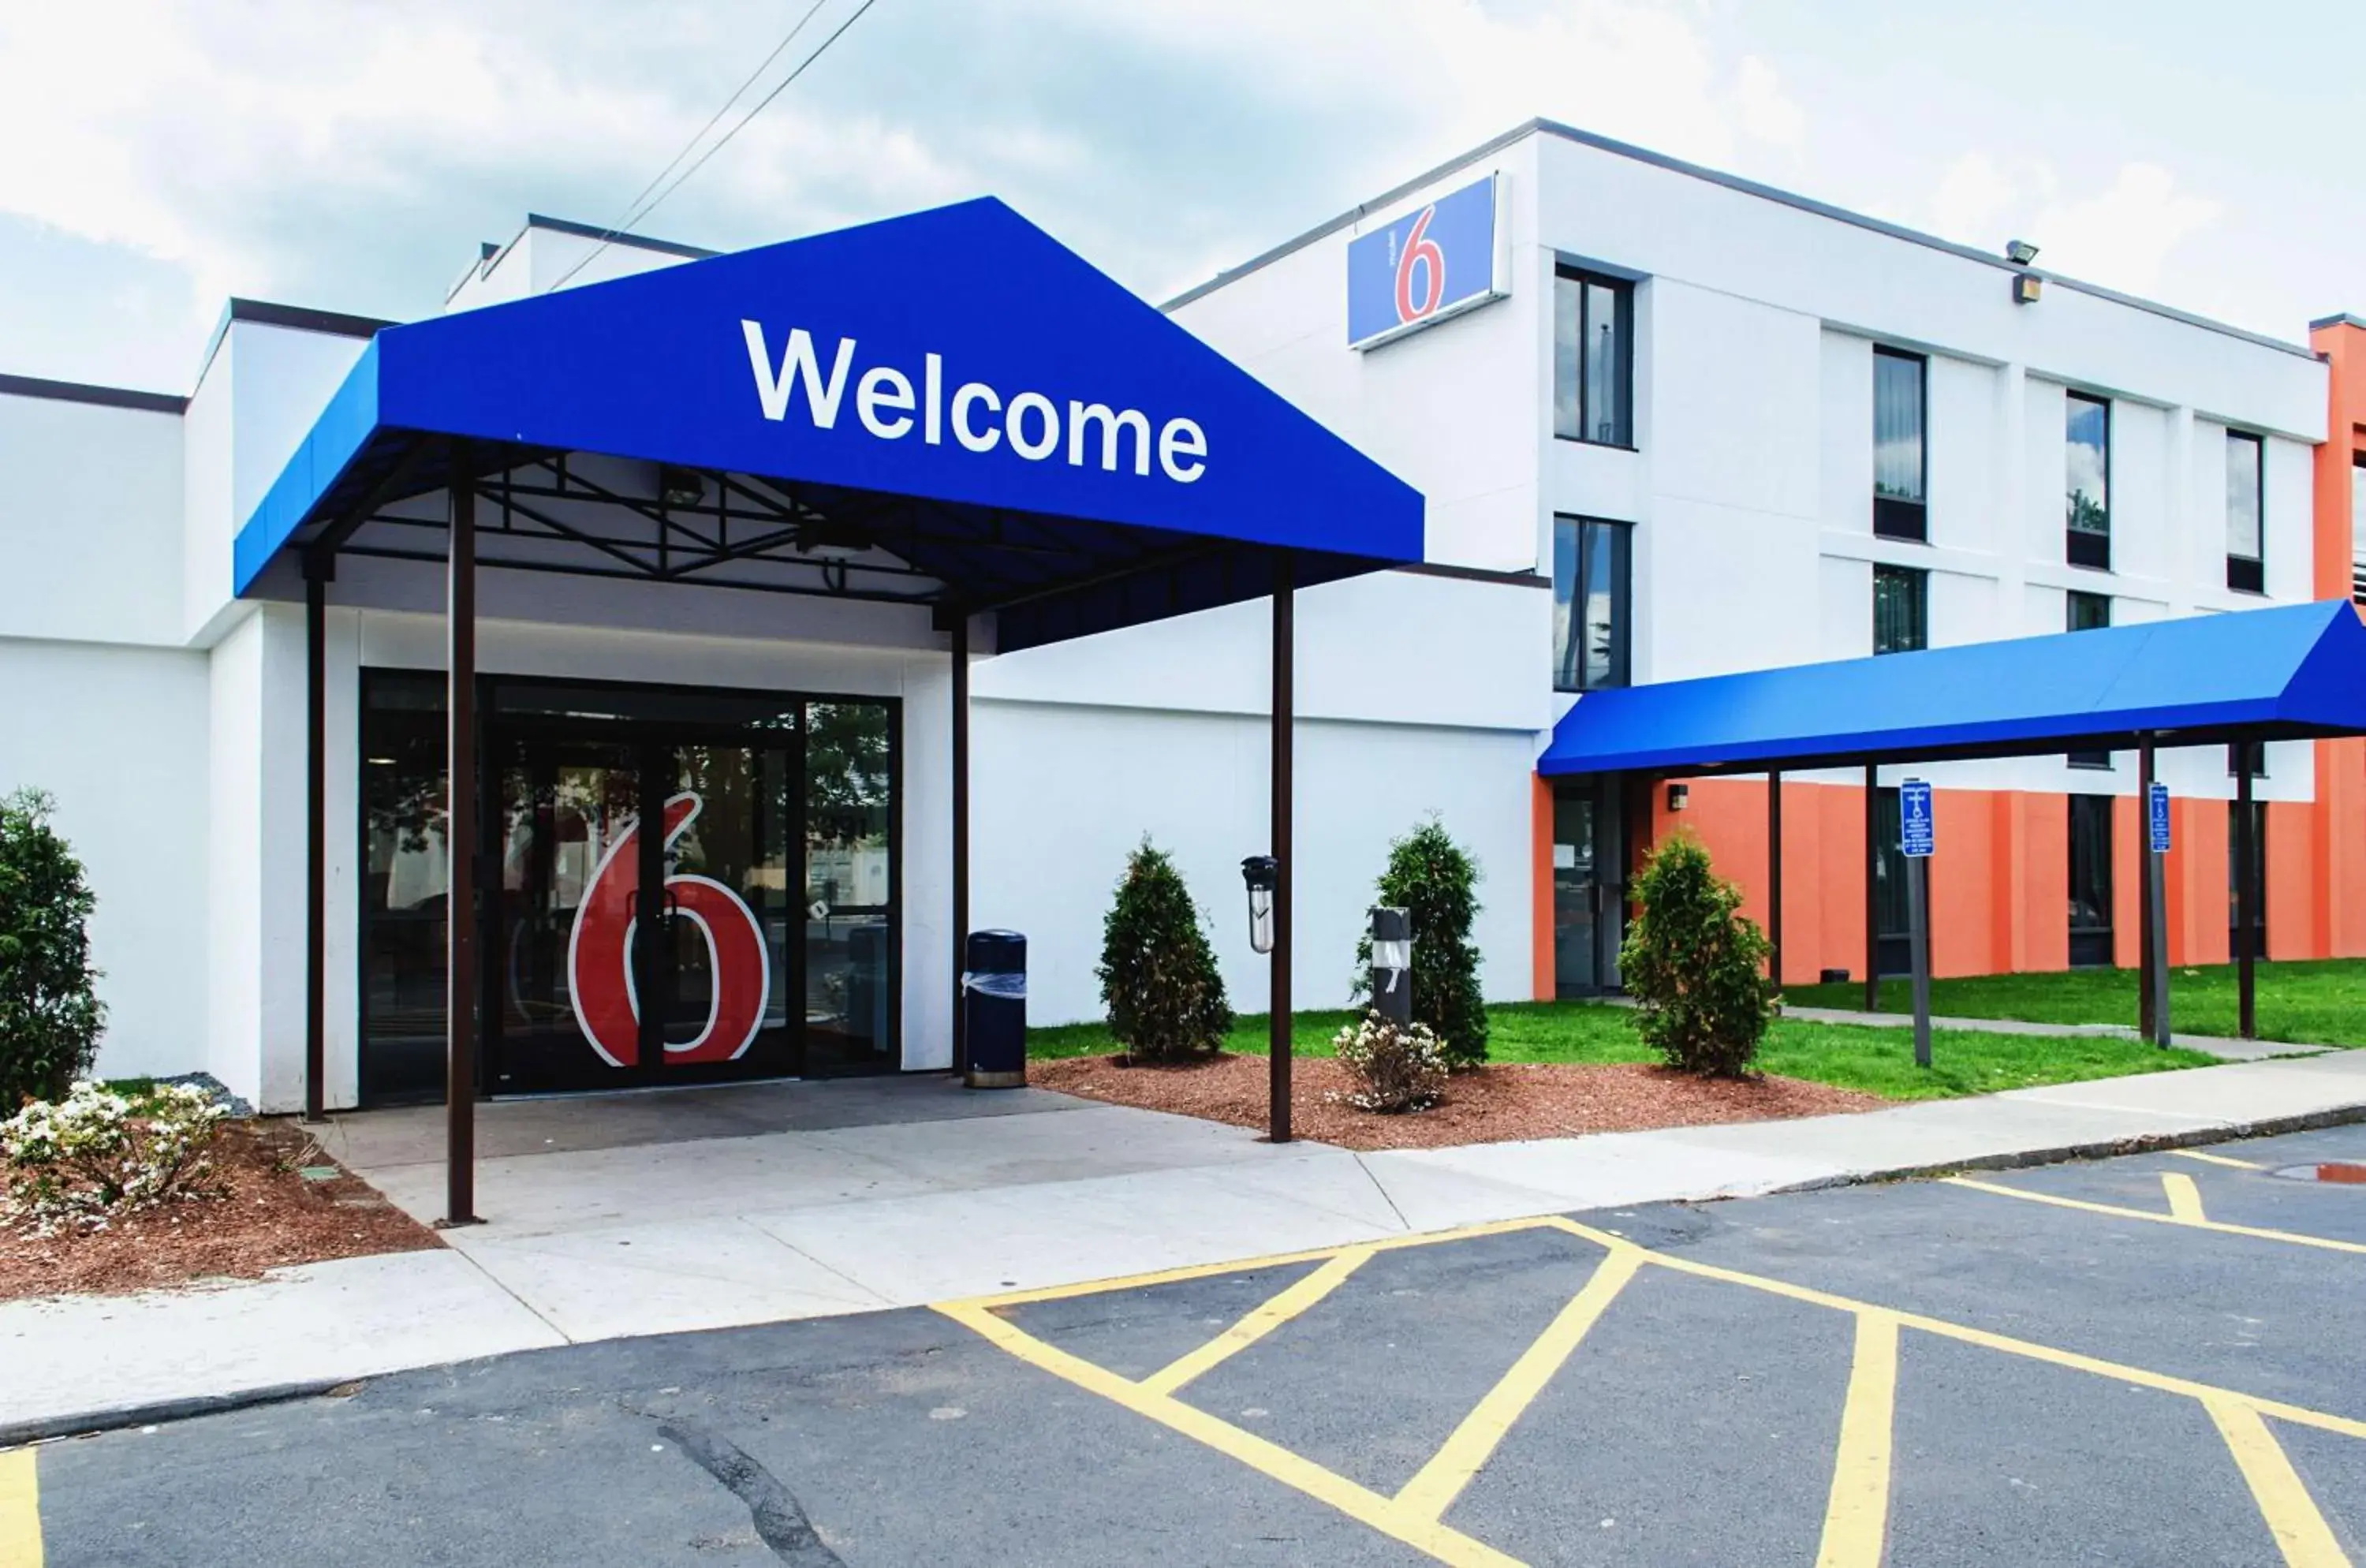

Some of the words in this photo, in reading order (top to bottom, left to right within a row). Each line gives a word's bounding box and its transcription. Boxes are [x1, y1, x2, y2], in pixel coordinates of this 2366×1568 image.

[1395, 203, 1445, 326] 6
[741, 319, 1207, 483] Welcome
[568, 790, 770, 1067] 6
